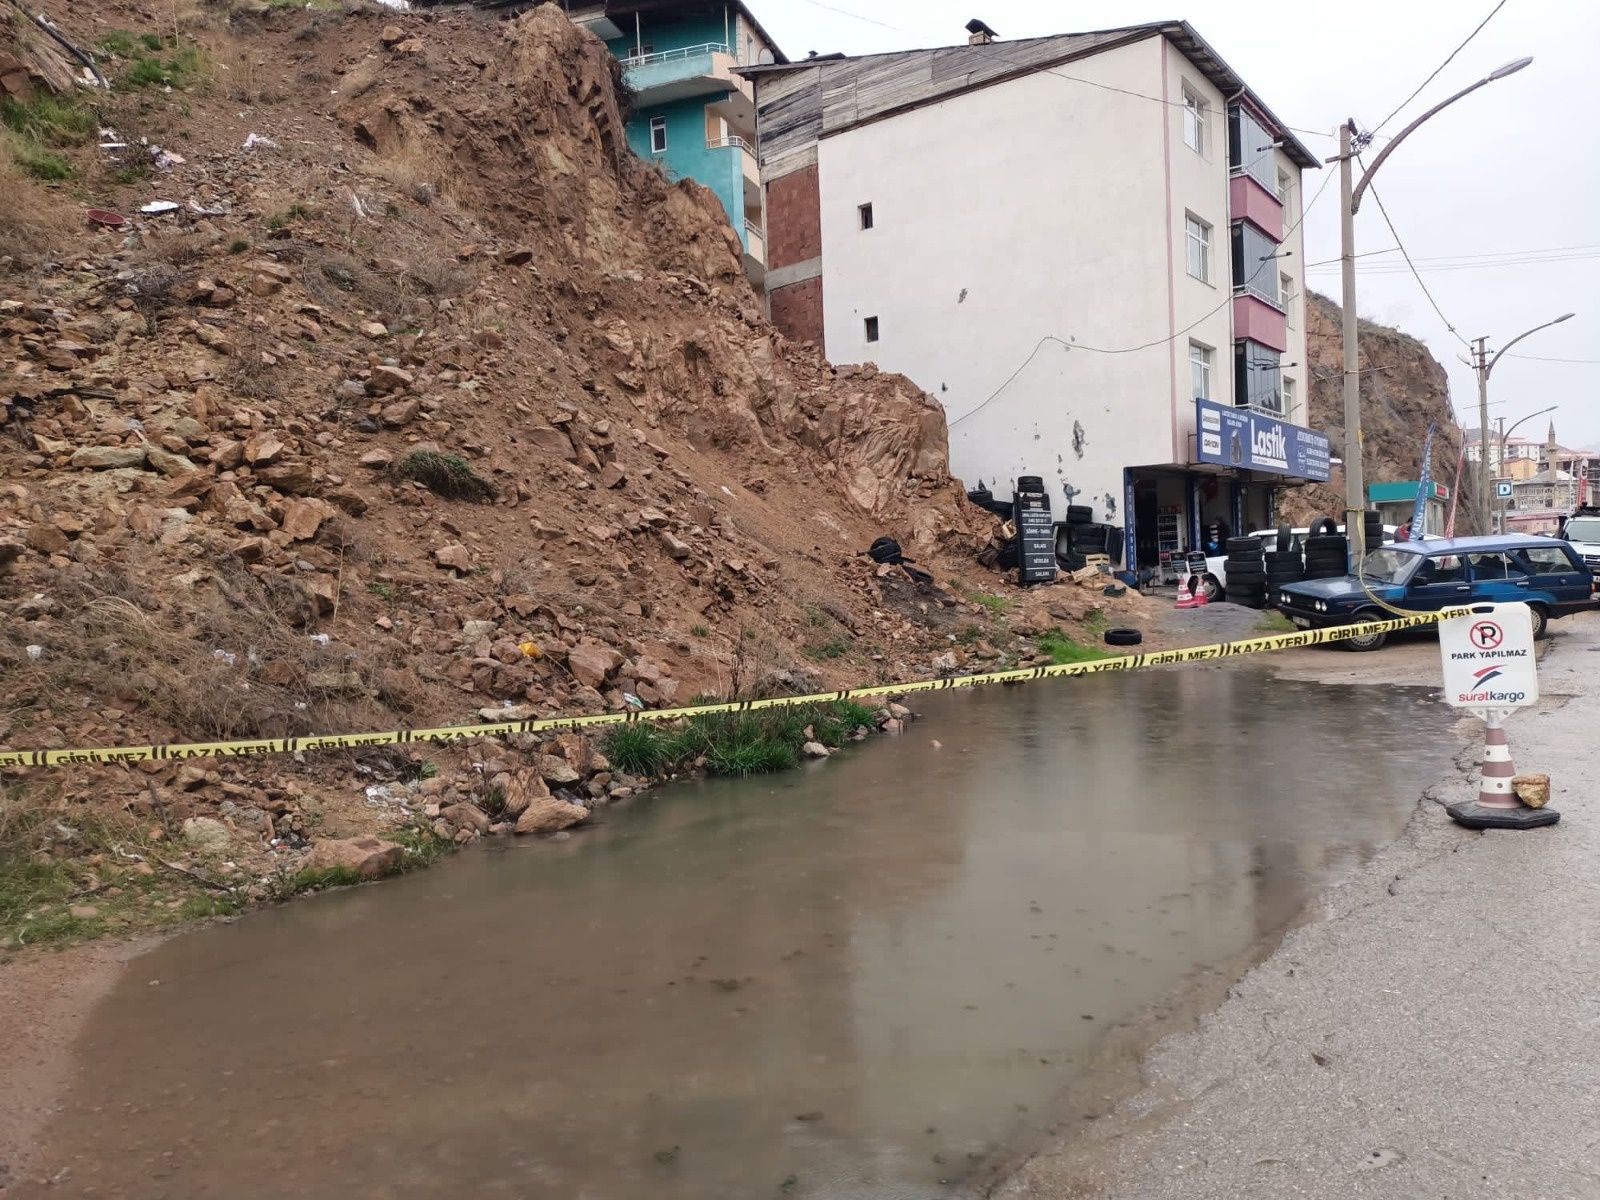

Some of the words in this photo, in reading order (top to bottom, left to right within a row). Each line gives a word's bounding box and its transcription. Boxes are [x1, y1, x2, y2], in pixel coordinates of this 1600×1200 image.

[1251, 419, 1286, 459] Lastik
[1499, 484, 1511, 495] D
[1451, 652, 1476, 660] PARK
[1479, 650, 1527, 659] YAPILMAZ
